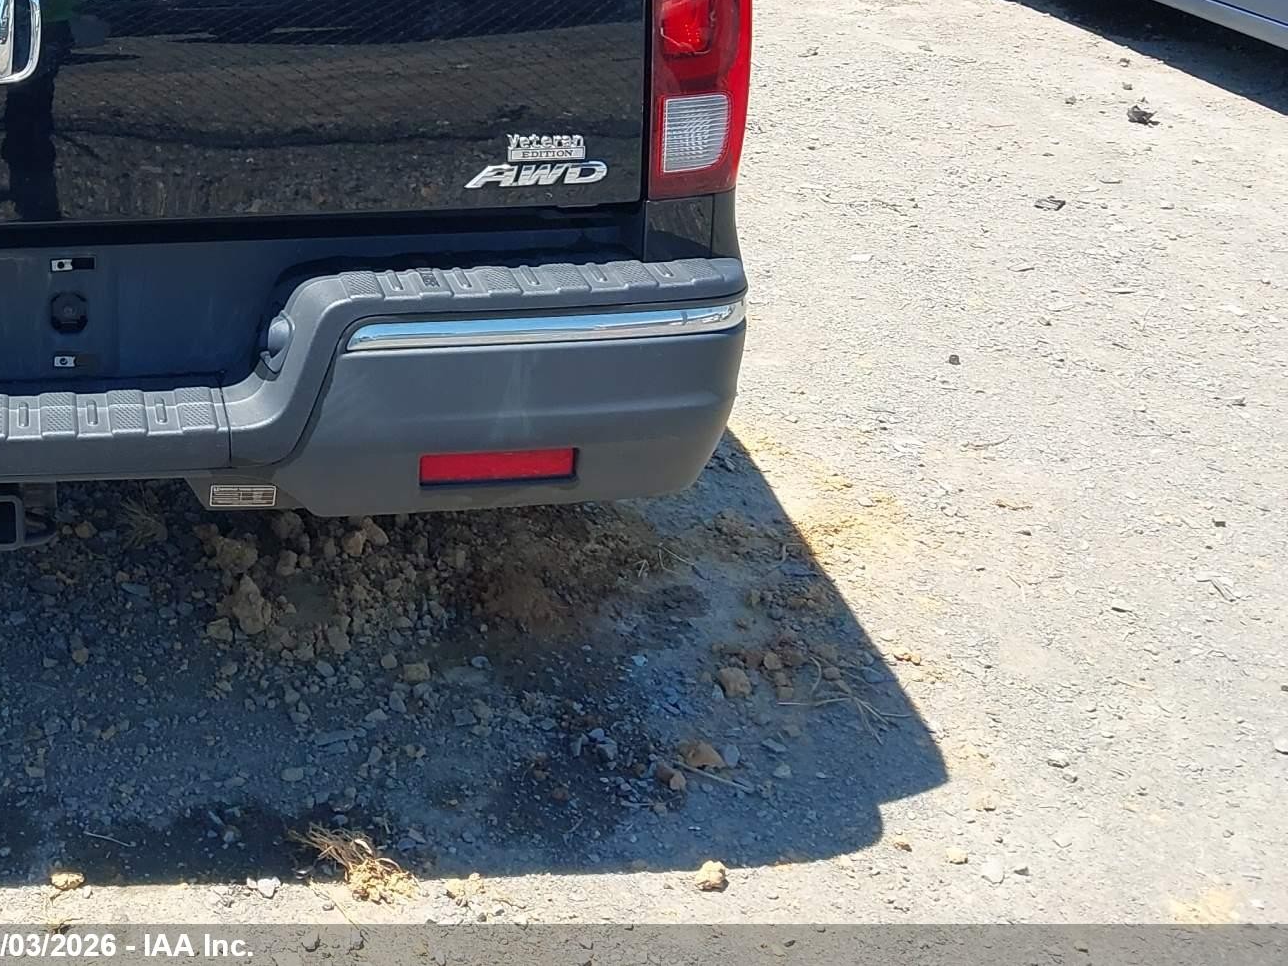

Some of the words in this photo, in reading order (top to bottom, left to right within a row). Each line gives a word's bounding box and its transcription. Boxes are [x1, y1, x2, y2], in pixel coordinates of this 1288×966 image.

[507, 133, 585, 150] Veteran
[521, 149, 574, 159] EDITION
[464, 160, 608, 189] AWD
